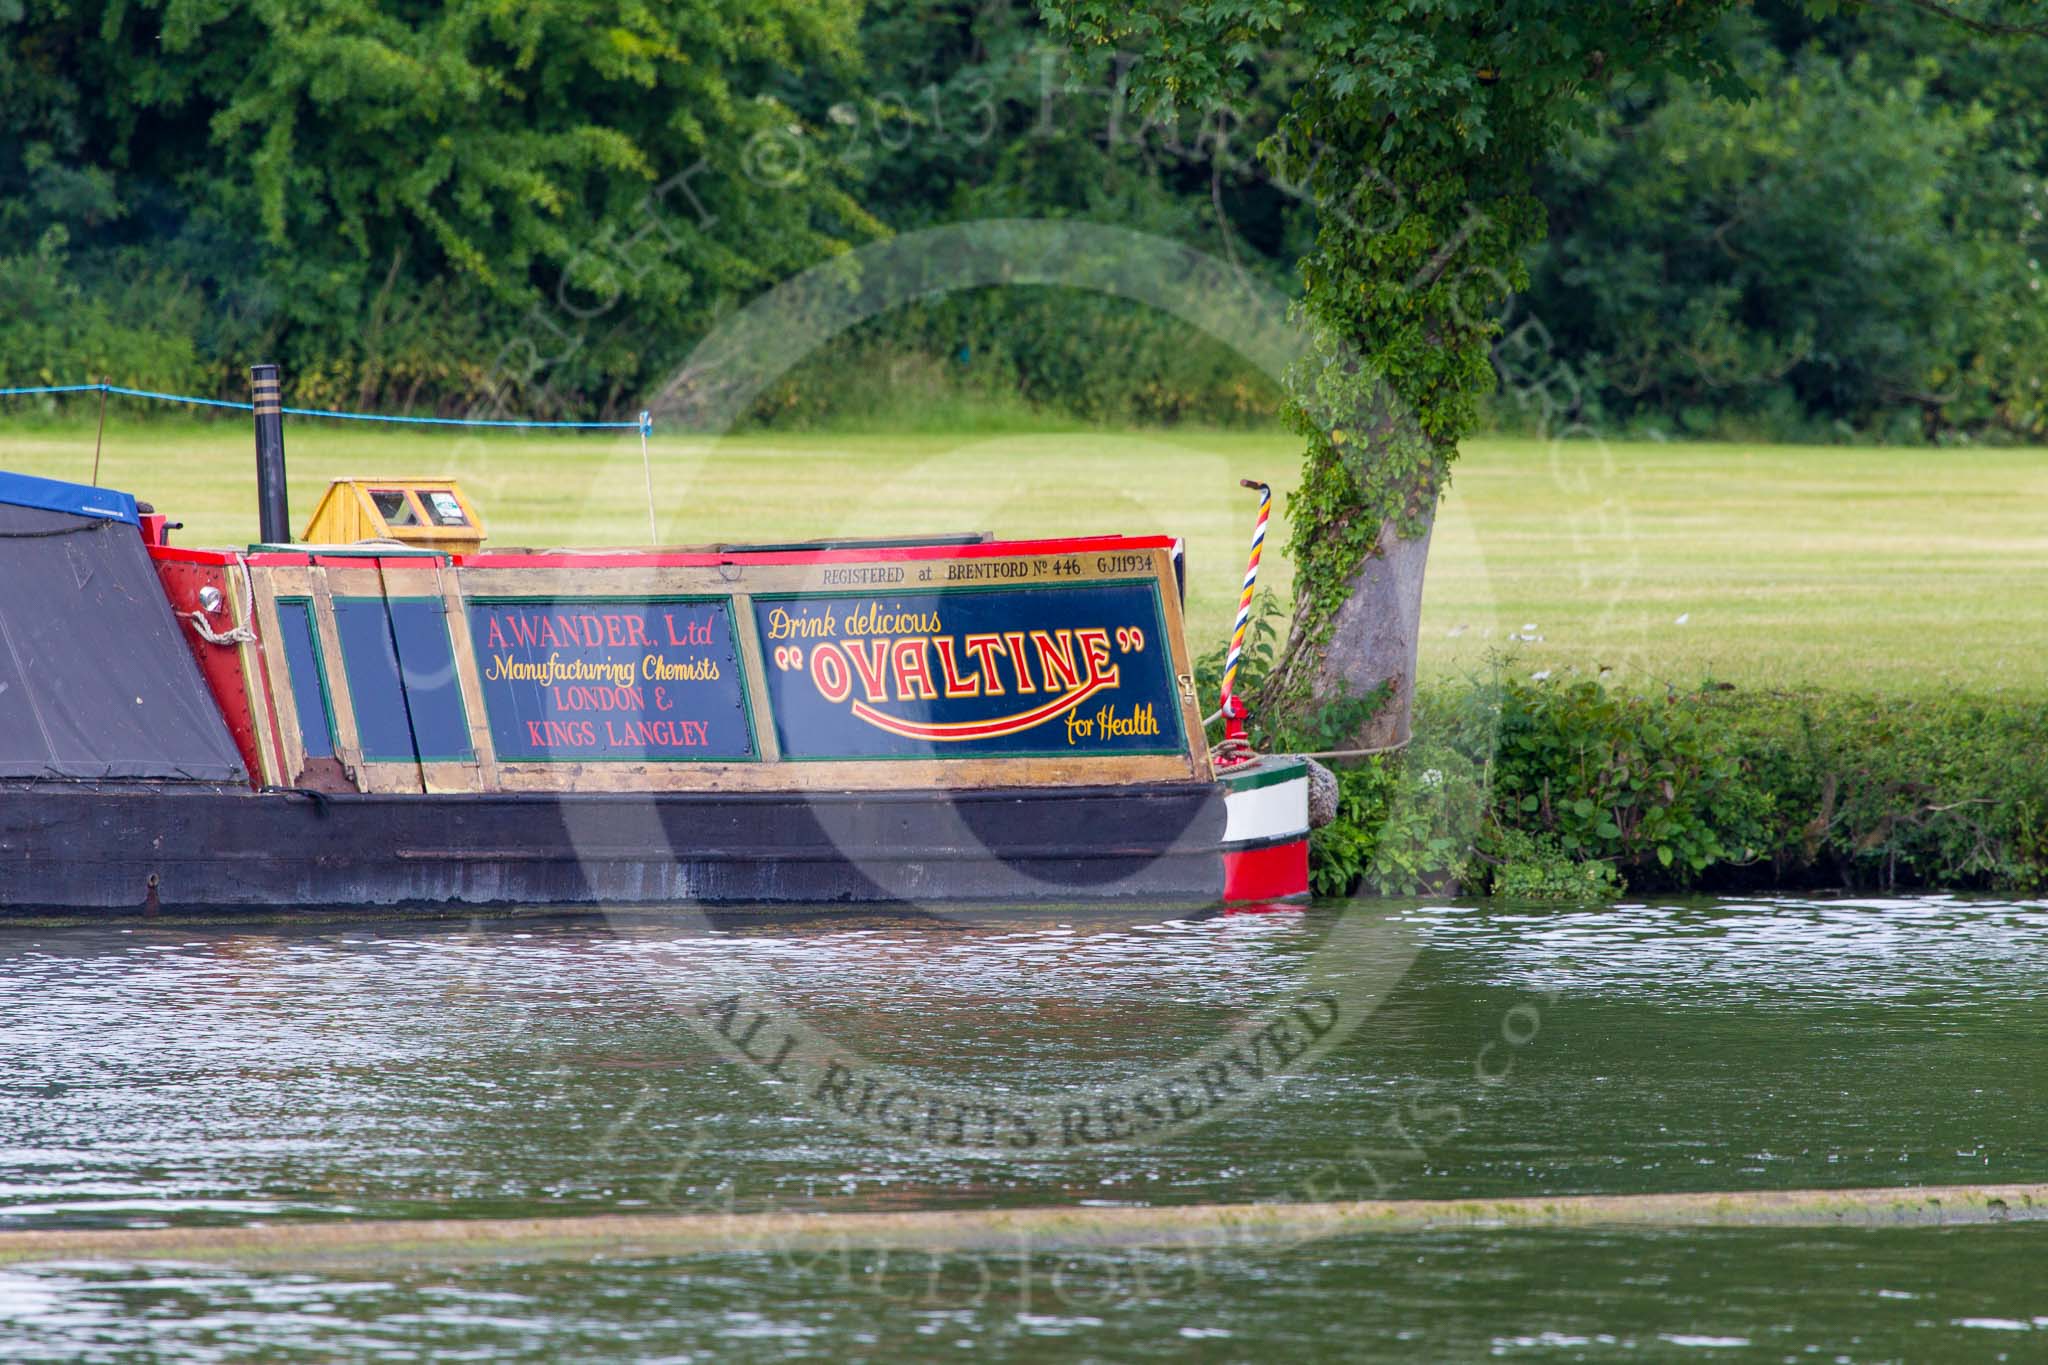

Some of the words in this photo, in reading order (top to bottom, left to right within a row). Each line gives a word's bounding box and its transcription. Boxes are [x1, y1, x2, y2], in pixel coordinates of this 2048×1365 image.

[823, 567, 905, 585] REGISTERED
[918, 566, 933, 582] at
[947, 561, 1029, 580] BRENTFORD
[1053, 559, 1081, 576] 446
[664, 612, 715, 647] Ltd
[768, 606, 837, 639] Drink
[844, 601, 942, 636] delicious
[485, 652, 636, 689] Manufacturing
[642, 654, 721, 681] Chemists
[554, 686, 646, 712] LONDON
[527, 720, 596, 747] KINGS
[606, 720, 709, 747] LANGLEY
[1064, 706, 1095, 746] for
[1096, 702, 1160, 741] Health
